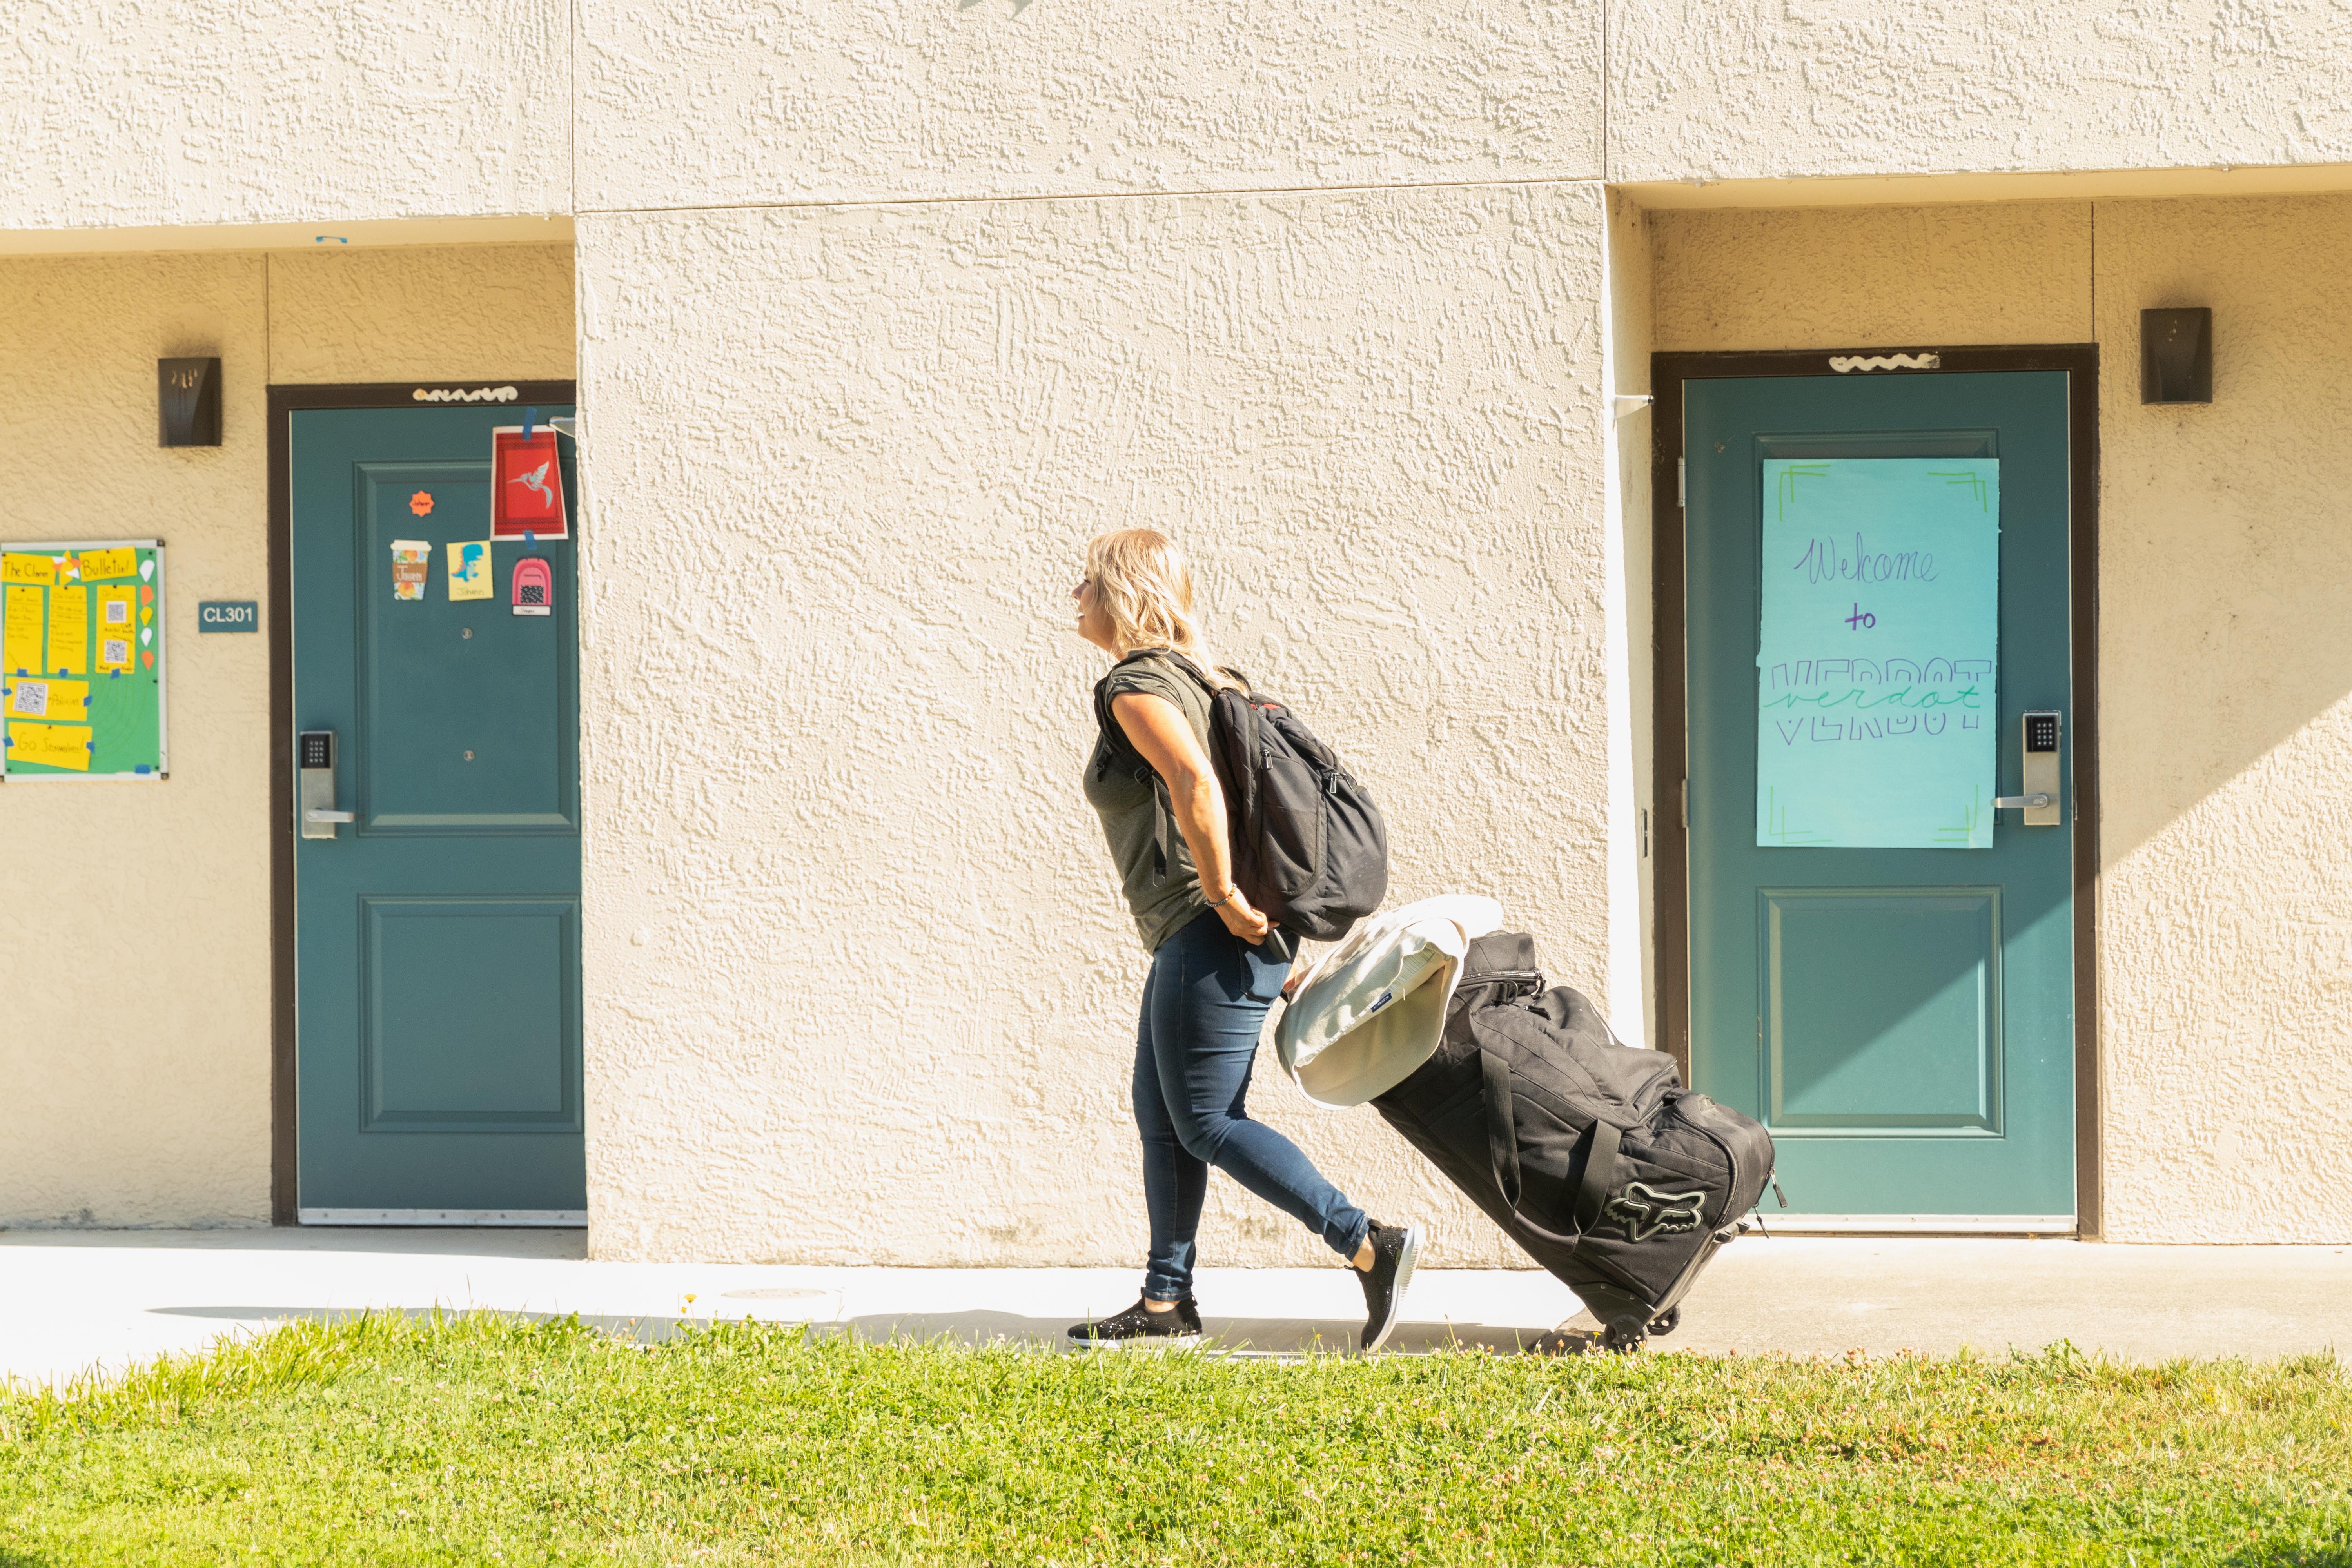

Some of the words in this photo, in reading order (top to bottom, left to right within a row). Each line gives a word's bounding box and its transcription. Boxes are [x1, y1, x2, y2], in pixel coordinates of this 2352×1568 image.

[1793, 532, 1938, 584] Welcome
[4, 561, 21, 577] The
[203, 606, 252, 622] CL301
[1844, 603, 1876, 630] to
[1763, 686, 1981, 708] verdot
[18, 731, 37, 751] Go
